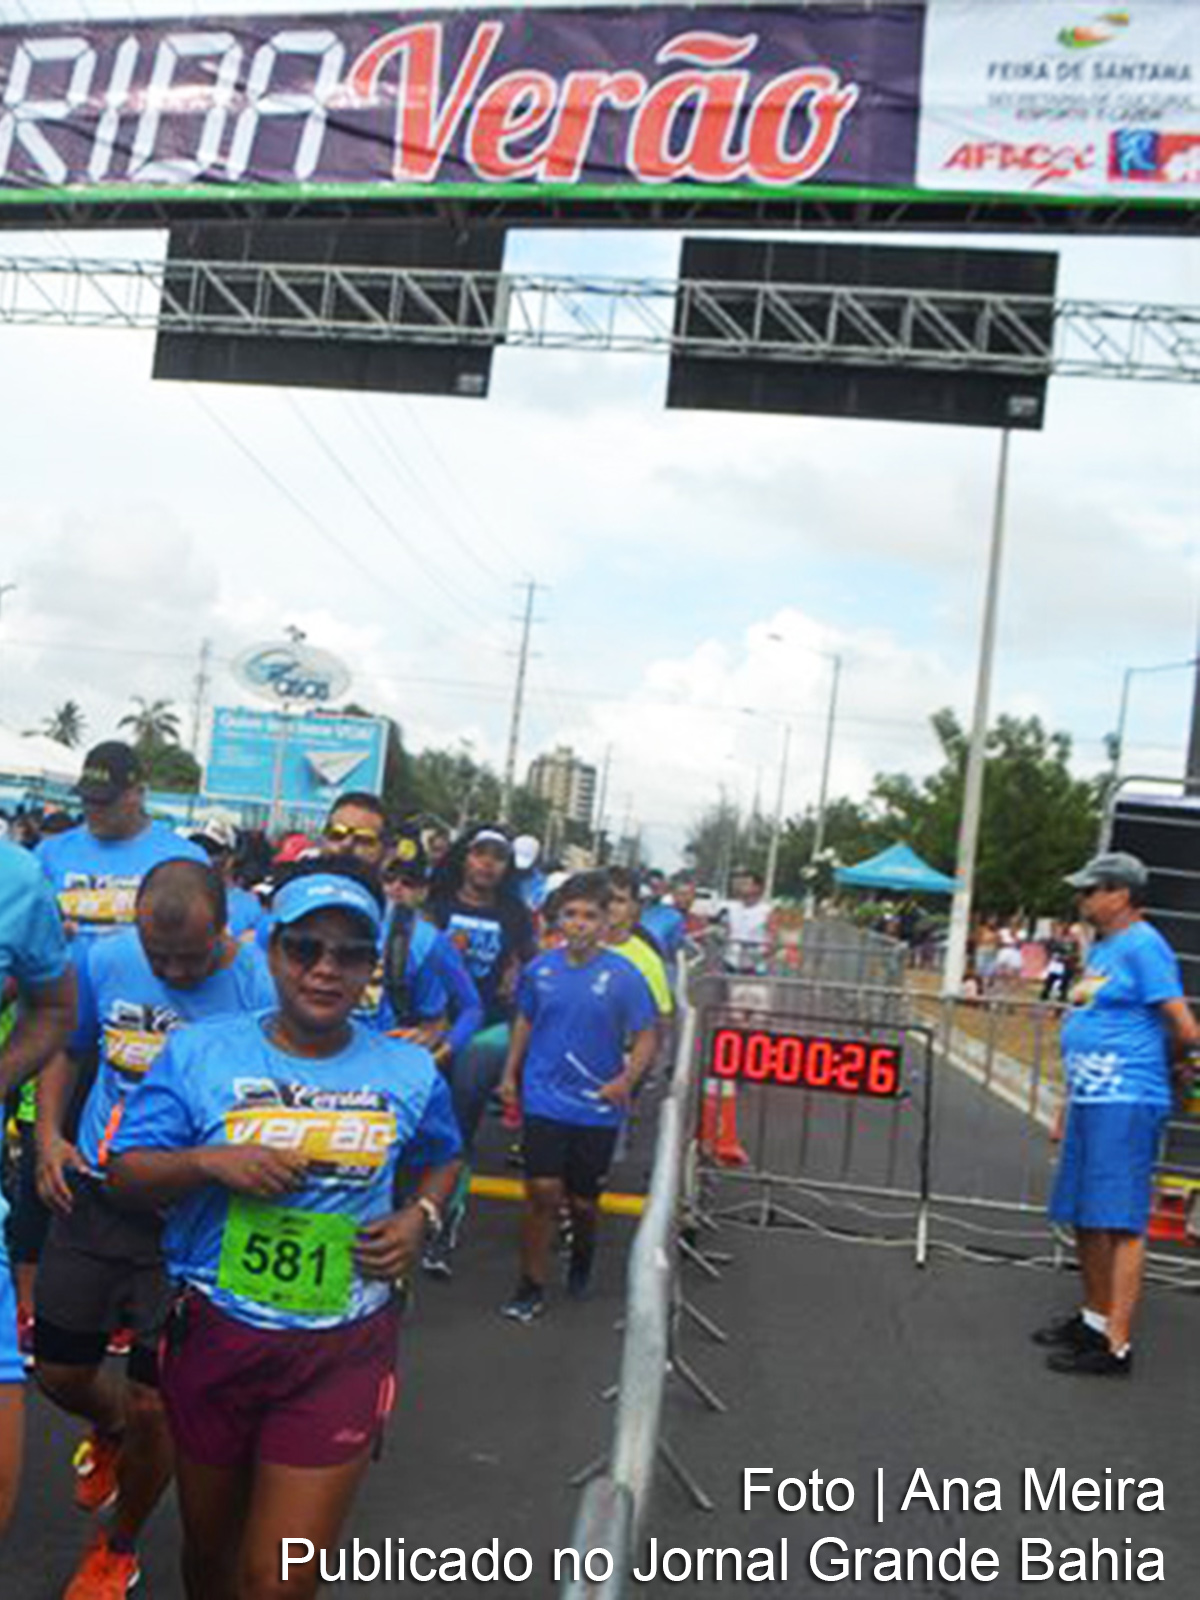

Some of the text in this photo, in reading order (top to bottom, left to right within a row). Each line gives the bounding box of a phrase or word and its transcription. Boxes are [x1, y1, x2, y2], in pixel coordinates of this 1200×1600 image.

[986, 61, 1192, 82] FEIRA DE SANTANA
[347, 21, 861, 187] Verão
[713, 1028, 897, 1094] 00:00:26
[241, 1233, 328, 1288] 581
